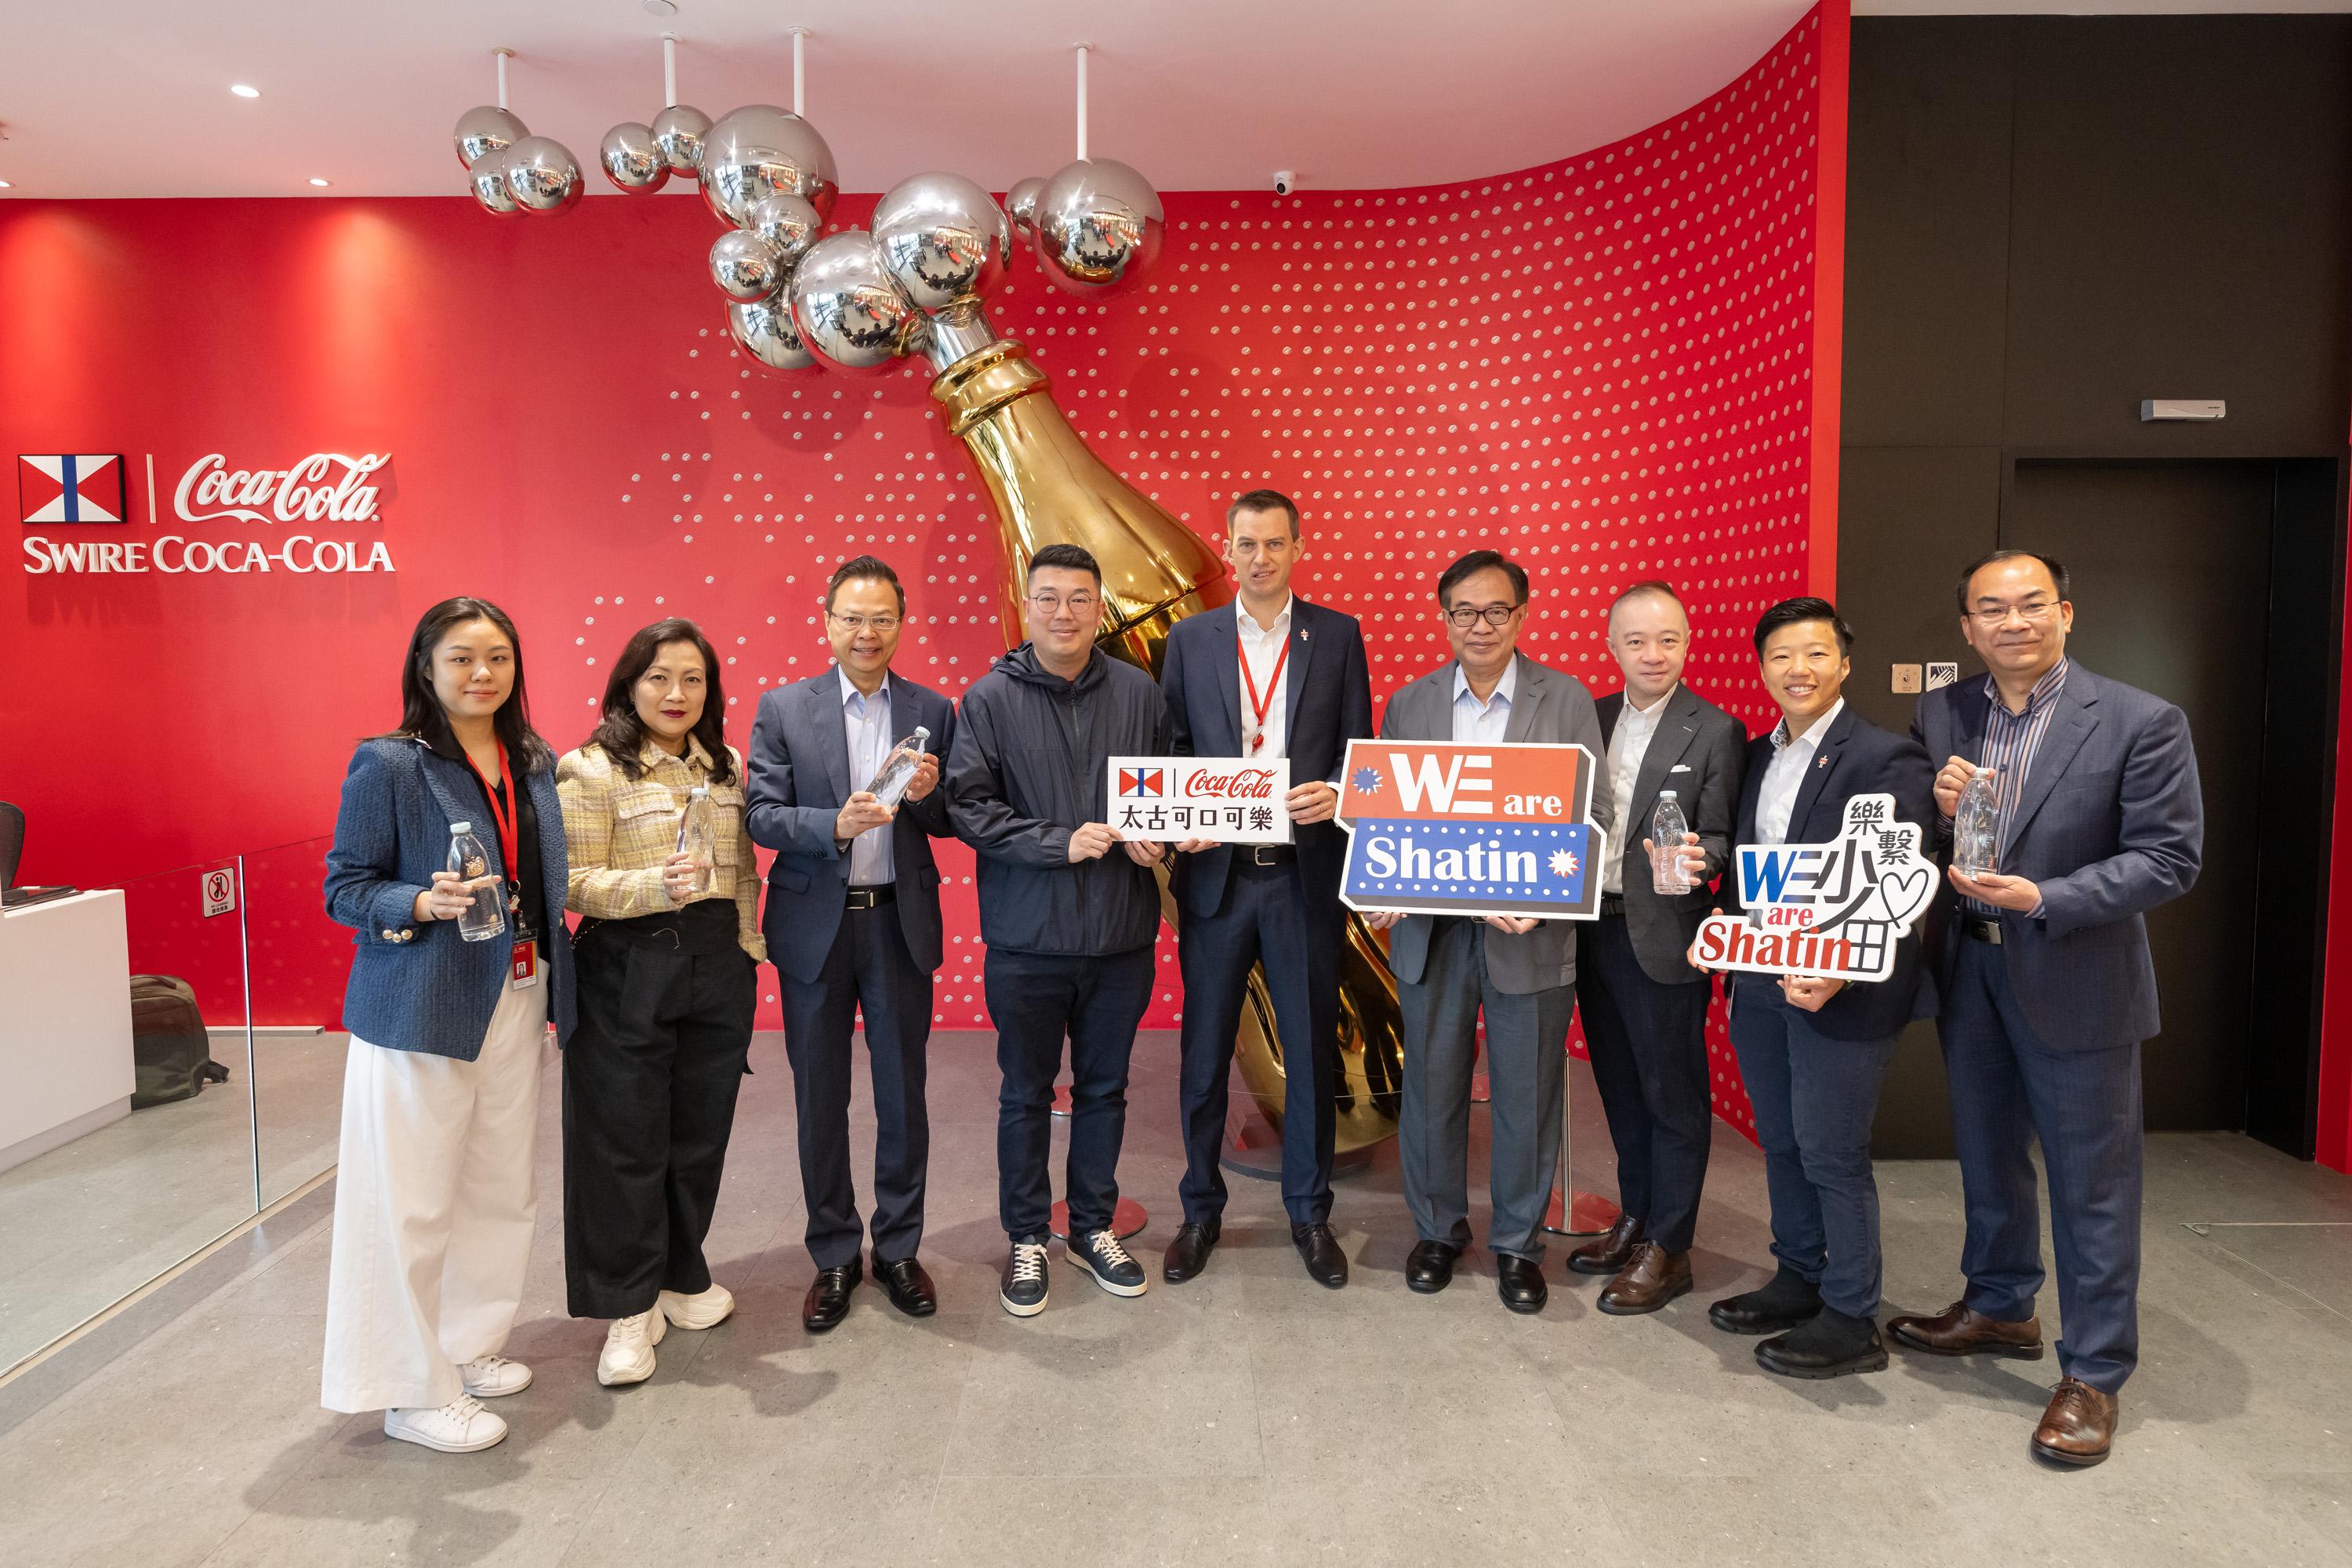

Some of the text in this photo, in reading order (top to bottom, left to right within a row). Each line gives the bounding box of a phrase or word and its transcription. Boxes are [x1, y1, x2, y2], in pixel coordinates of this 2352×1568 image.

[173, 452, 392, 523] Coca-Cola
[24, 535, 395, 573] SWIRE COCA-COLA
[1185, 768, 1278, 799] Coca-Cola
[1388, 753, 1563, 816] WE are
[1119, 804, 1272, 831] 太古可口可樂
[1365, 837, 1537, 883] Shatin
[1767, 907, 1813, 927] are
[1699, 922, 1852, 971] Shatin
